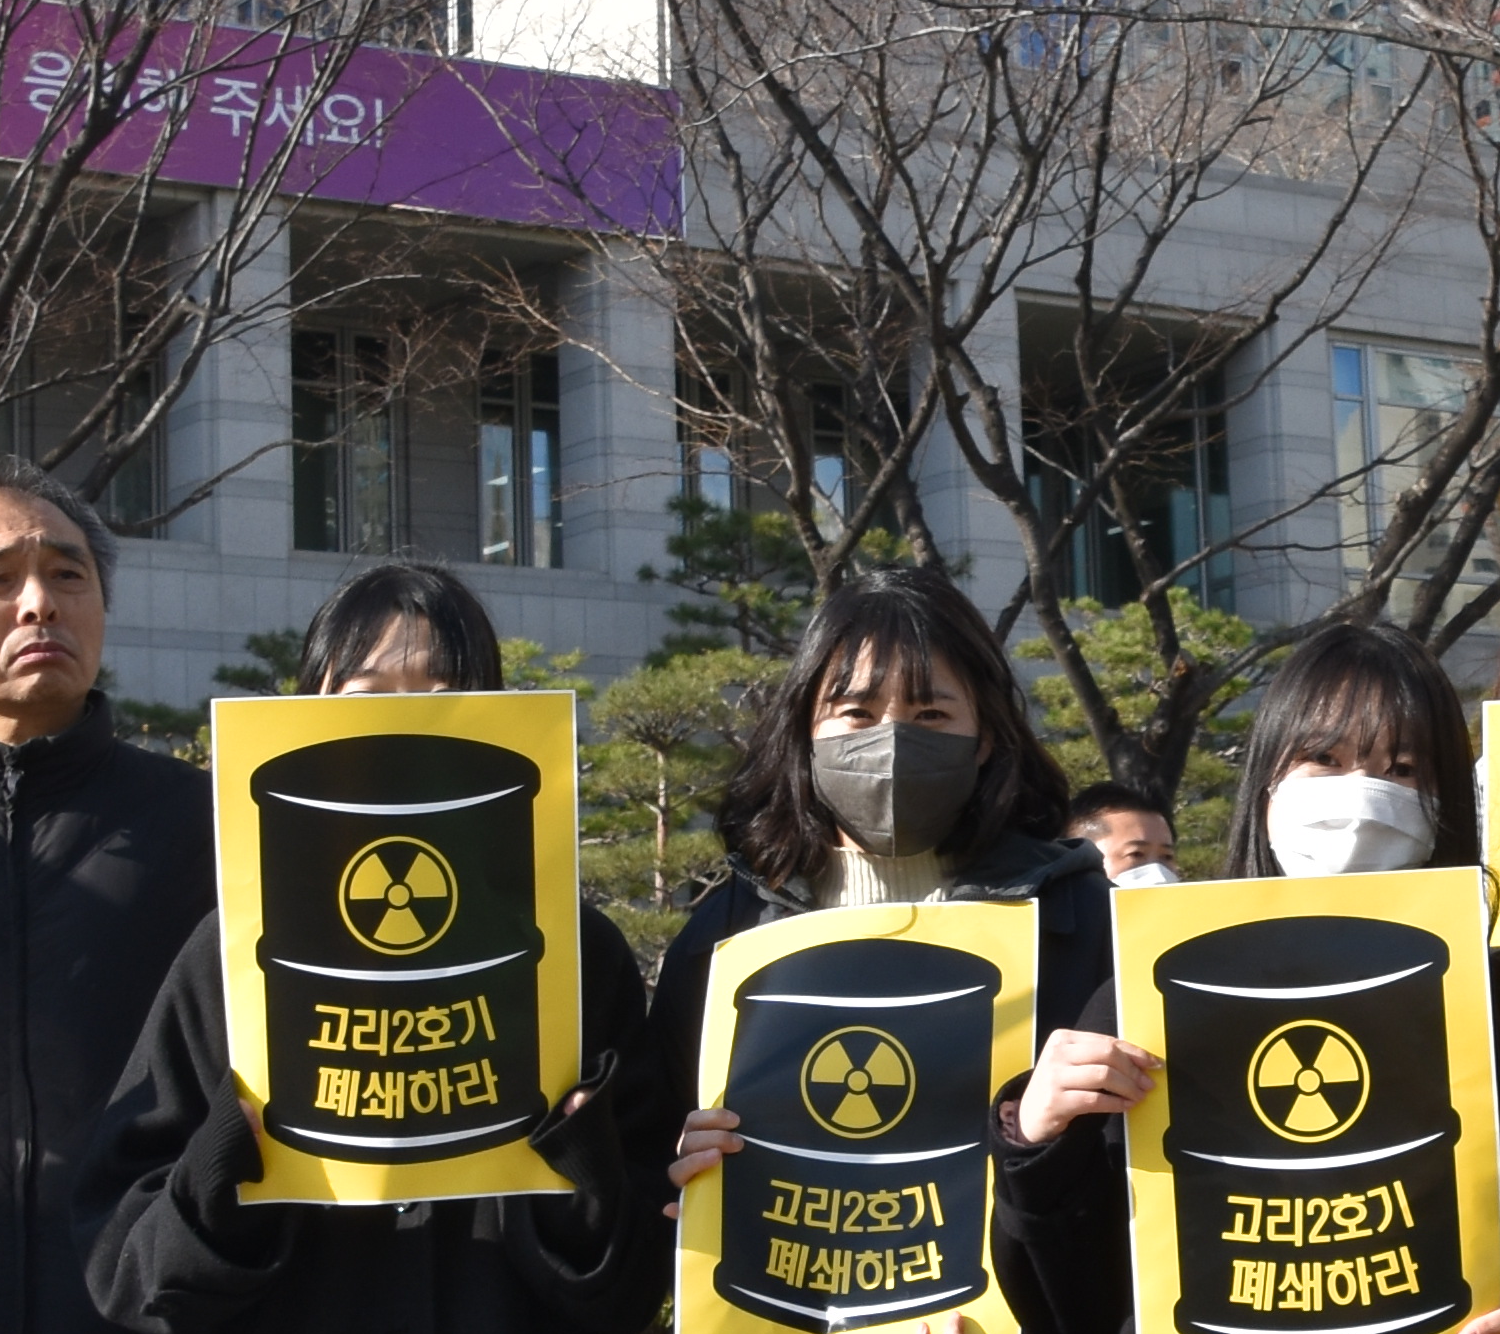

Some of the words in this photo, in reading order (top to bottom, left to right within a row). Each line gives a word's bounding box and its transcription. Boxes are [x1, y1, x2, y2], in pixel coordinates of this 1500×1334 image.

[308, 996, 496, 1056] 고리2호기
[314, 1058, 498, 1119] 폐쇄하라
[762, 1179, 945, 1234] 고리2호기
[1221, 1180, 1415, 1247] 고리2호기
[765, 1238, 943, 1294] 폐쇄하라
[1229, 1246, 1420, 1311] 폐쇄하라
